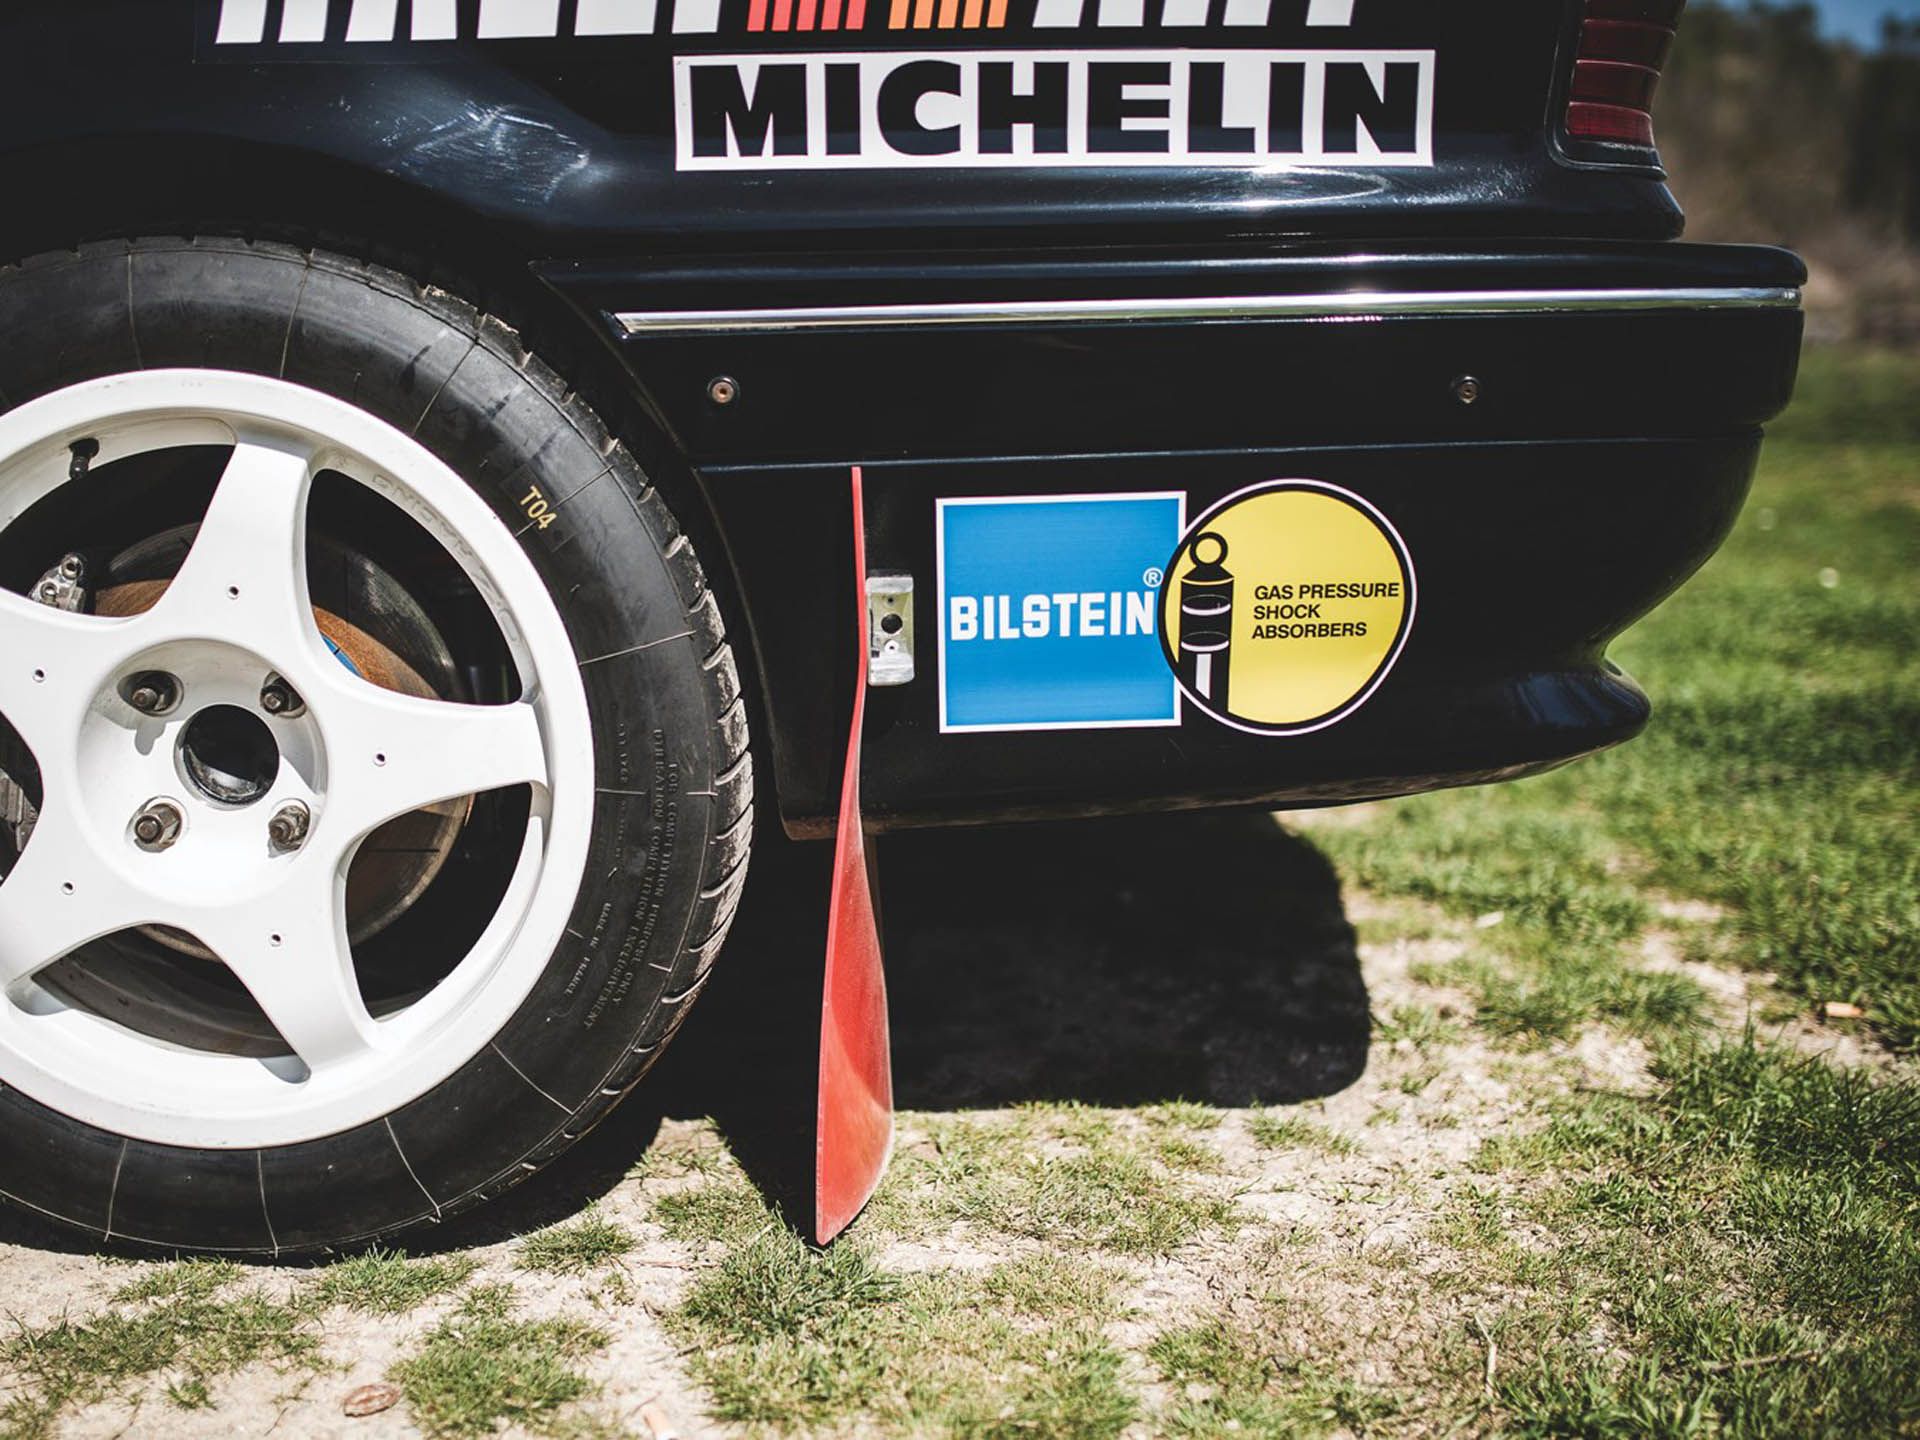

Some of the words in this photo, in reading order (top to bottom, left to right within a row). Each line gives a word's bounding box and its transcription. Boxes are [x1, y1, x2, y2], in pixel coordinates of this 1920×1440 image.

[689, 60, 1420, 158] MICHELIN
[519, 485, 558, 531] T04
[1254, 584, 1294, 601] GAS
[1299, 582, 1400, 600] PRESSURE
[950, 591, 1155, 641] BILSTEIN
[1253, 604, 1321, 620] SHOCK
[1252, 622, 1367, 640] ABSORBERS
